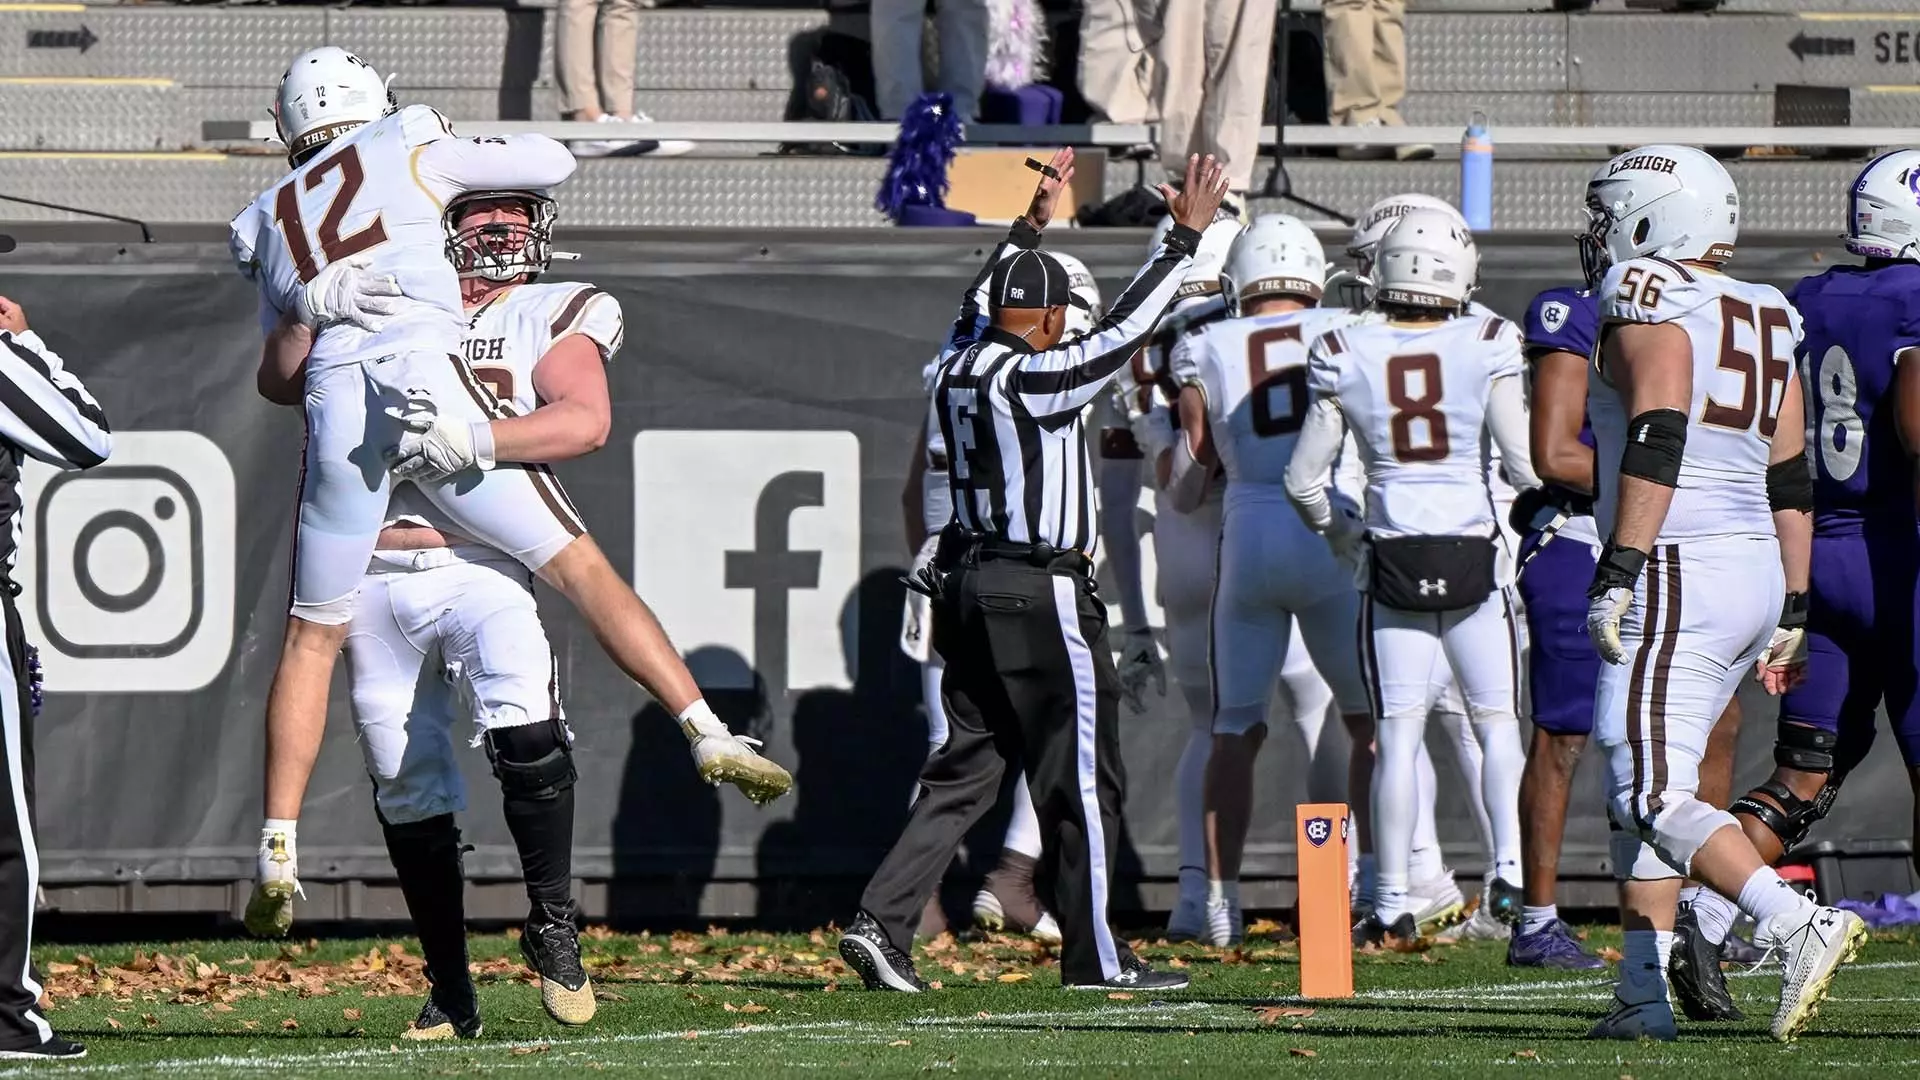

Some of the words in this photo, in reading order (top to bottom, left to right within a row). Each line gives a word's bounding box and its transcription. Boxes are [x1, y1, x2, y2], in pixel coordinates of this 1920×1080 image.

[316, 85, 326, 98] 12
[303, 130, 329, 146] THE
[1607, 155, 1678, 178] LEHIGH
[1858, 180, 1868, 192] 8
[274, 143, 390, 286] 12
[1362, 204, 1417, 233] LEHIG
[1010, 287, 1025, 300] RR
[1257, 281, 1281, 291] THE
[1284, 281, 1312, 292] NEST
[1387, 290, 1408, 301] THE
[1412, 293, 1441, 306] NEST
[1615, 267, 1668, 310] 56
[460, 337, 506, 361] IGH
[1697, 292, 1795, 440] 56
[1247, 322, 1309, 440] 6
[1385, 352, 1451, 464] 8
[948, 388, 979, 480] F
